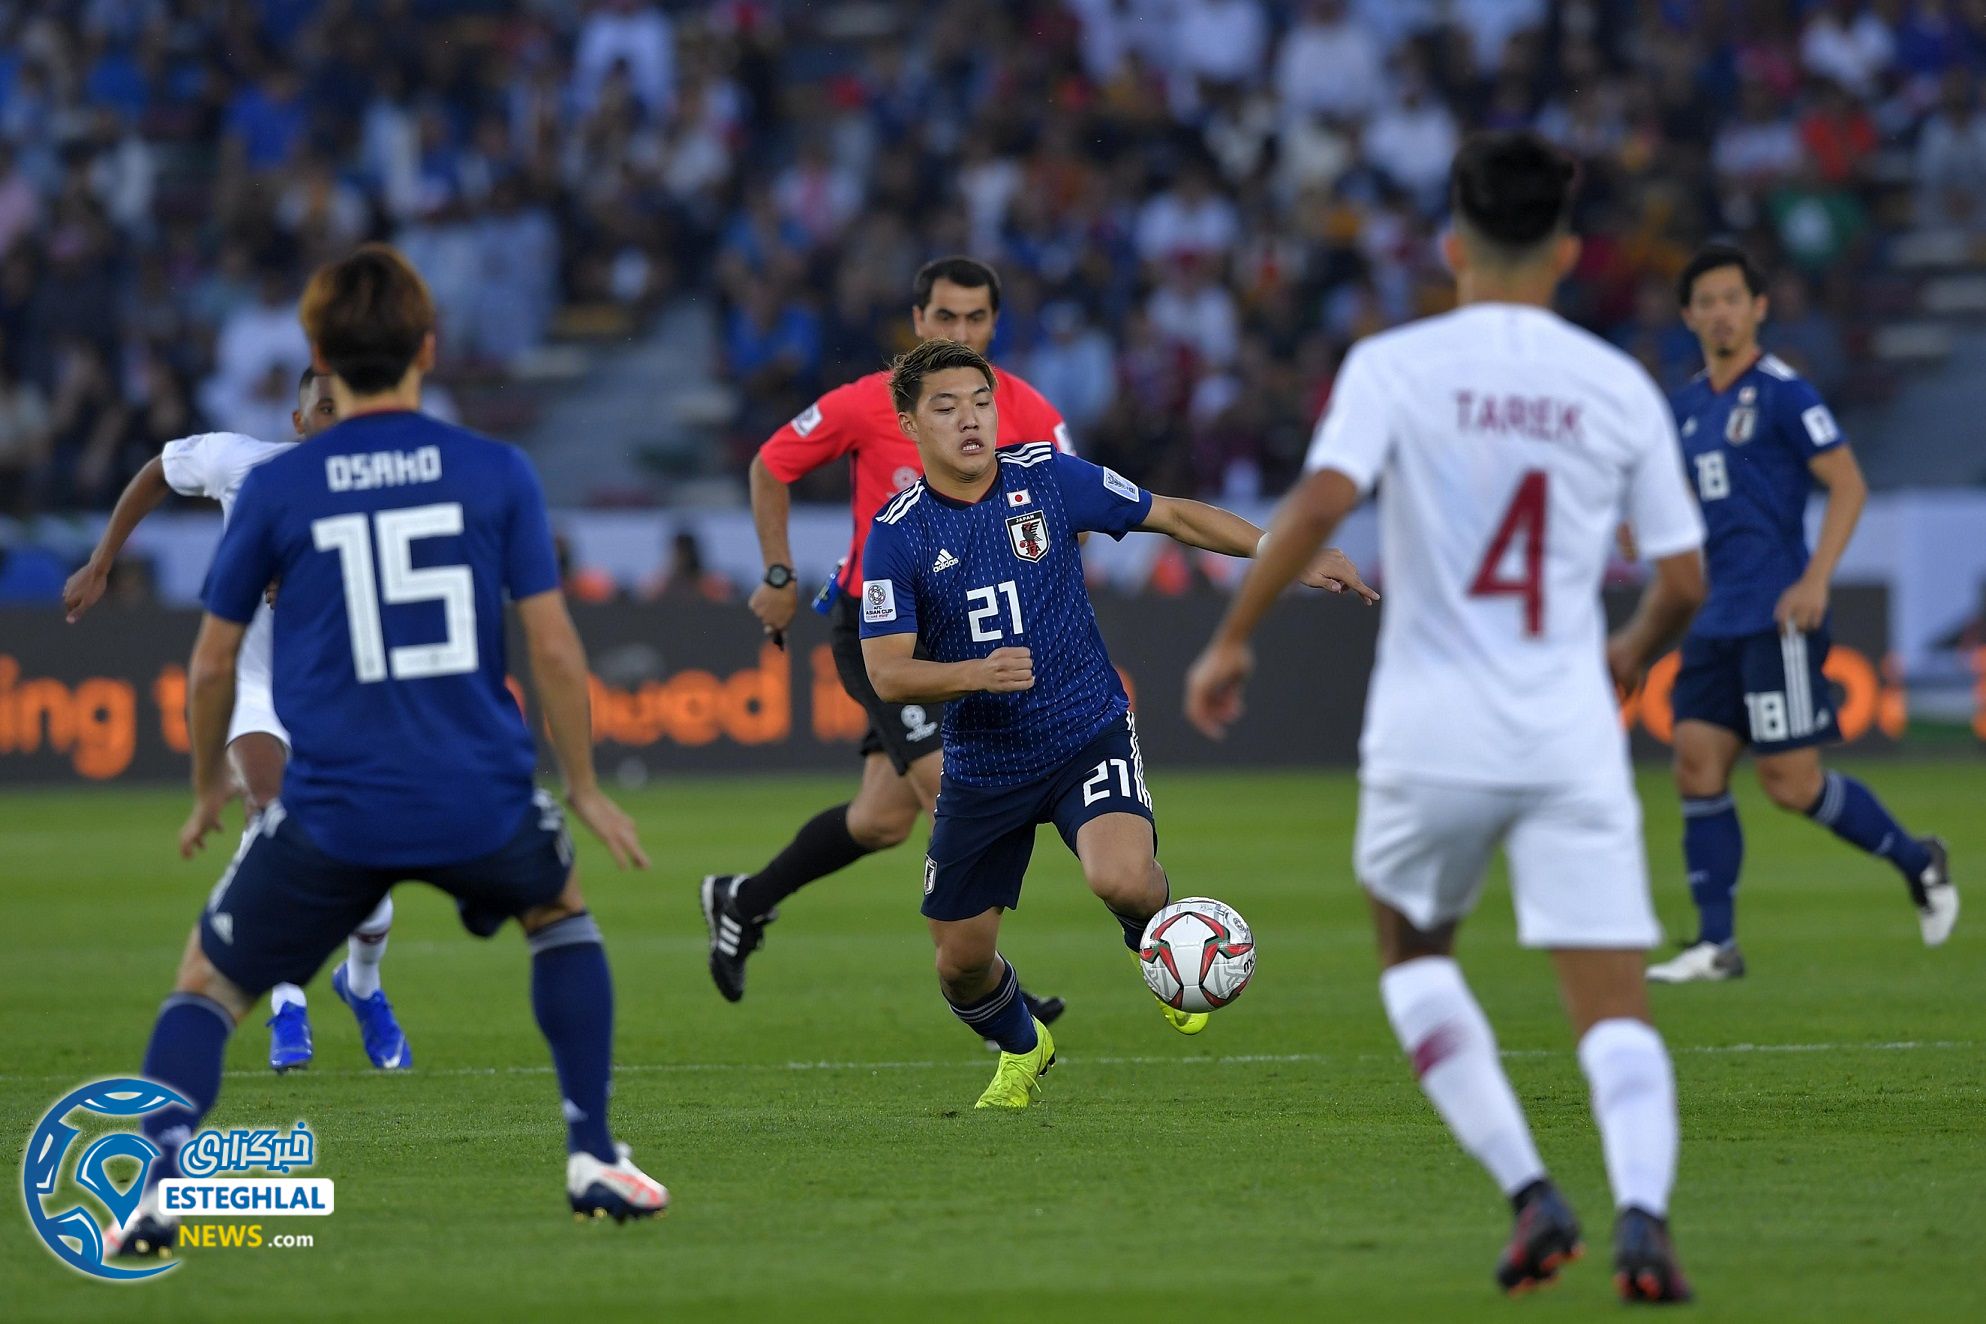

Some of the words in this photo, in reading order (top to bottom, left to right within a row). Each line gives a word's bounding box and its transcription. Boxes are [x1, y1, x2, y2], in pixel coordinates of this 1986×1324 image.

[1456, 389, 1586, 443] TAREK
[325, 444, 443, 492] OSAKO
[1694, 450, 1731, 501] 18
[1015, 514, 1035, 523] JAPAN
[932, 557, 959, 573] adidas
[1465, 467, 1549, 640] 4
[311, 501, 479, 684] 15
[966, 580, 1024, 643] 21
[1744, 690, 1790, 742] 18
[1083, 758, 1131, 808] 21
